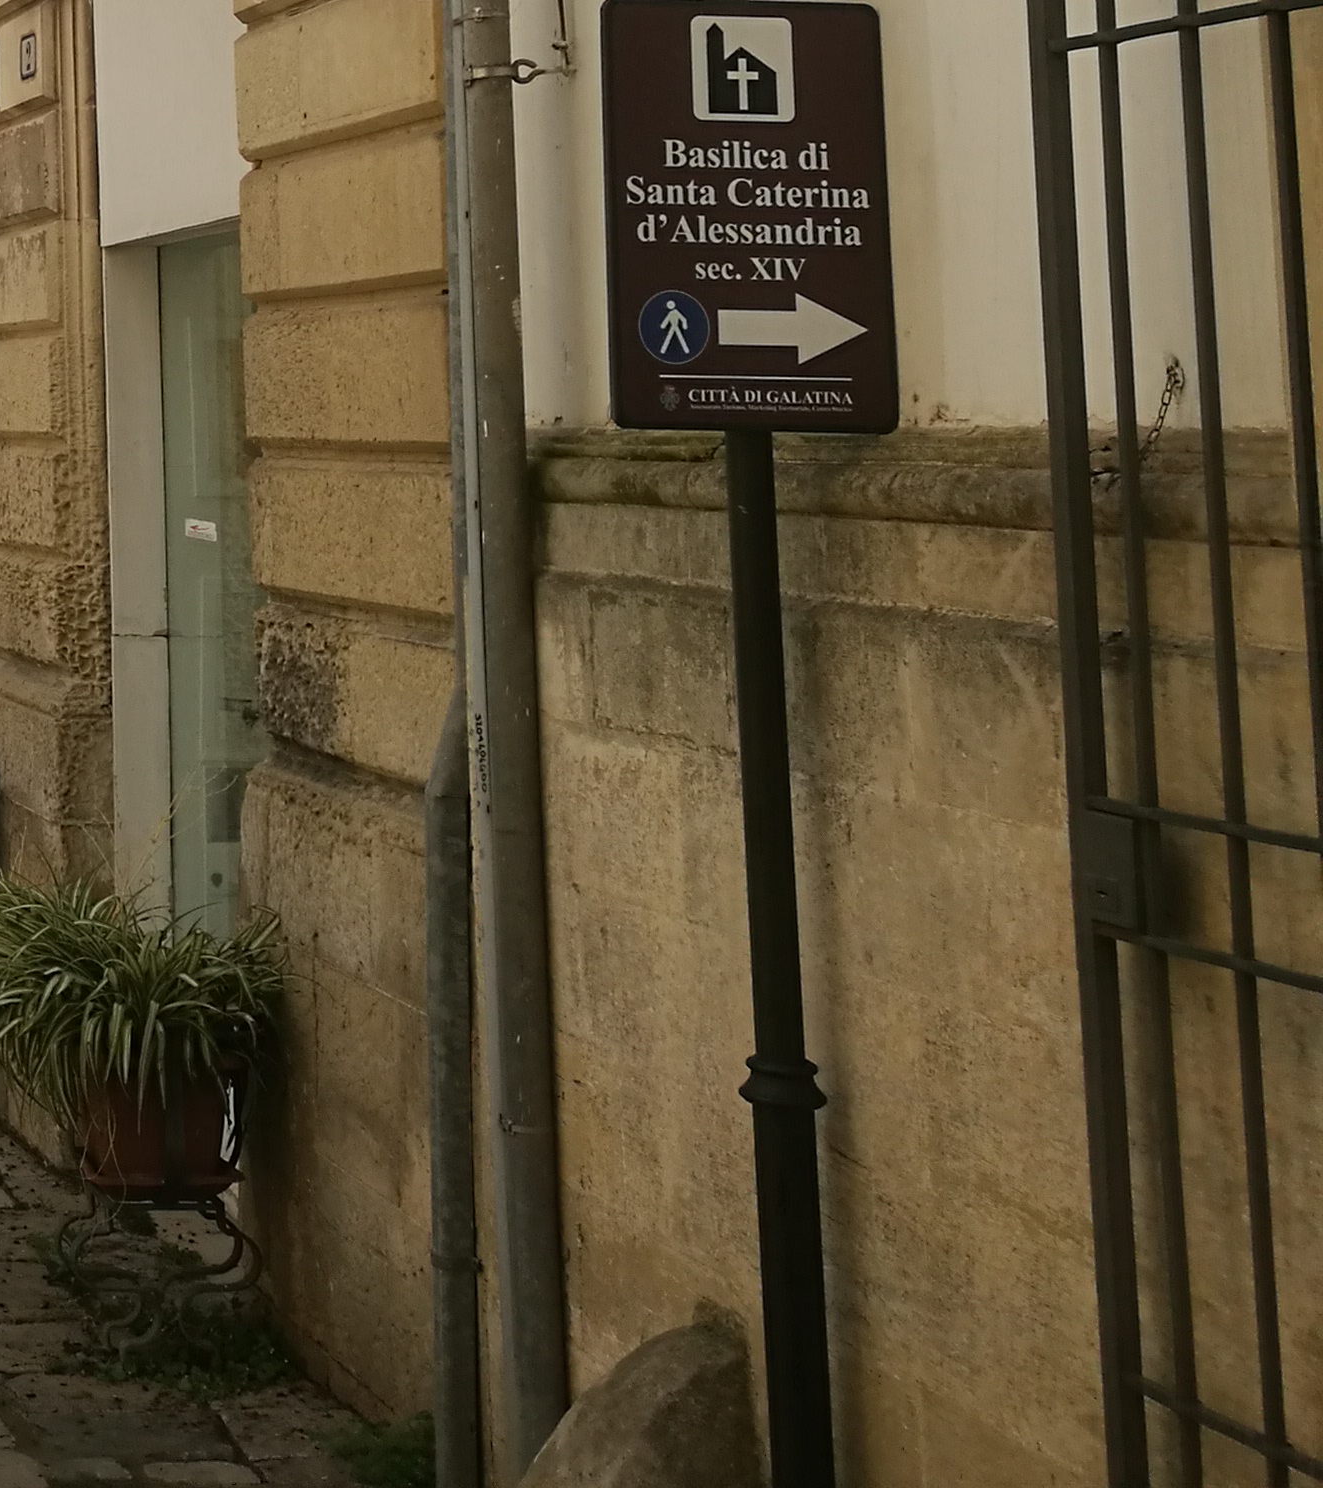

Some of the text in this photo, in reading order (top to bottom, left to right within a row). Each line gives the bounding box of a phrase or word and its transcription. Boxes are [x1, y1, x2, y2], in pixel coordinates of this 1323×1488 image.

[663, 139, 831, 172] Basilica di
[625, 176, 871, 210] Santa Caterina
[636, 215, 863, 247] d'Alessandria
[694, 257, 806, 281] sec. XIV
[688, 386, 853, 405] CITTÀ DI GALATINA
